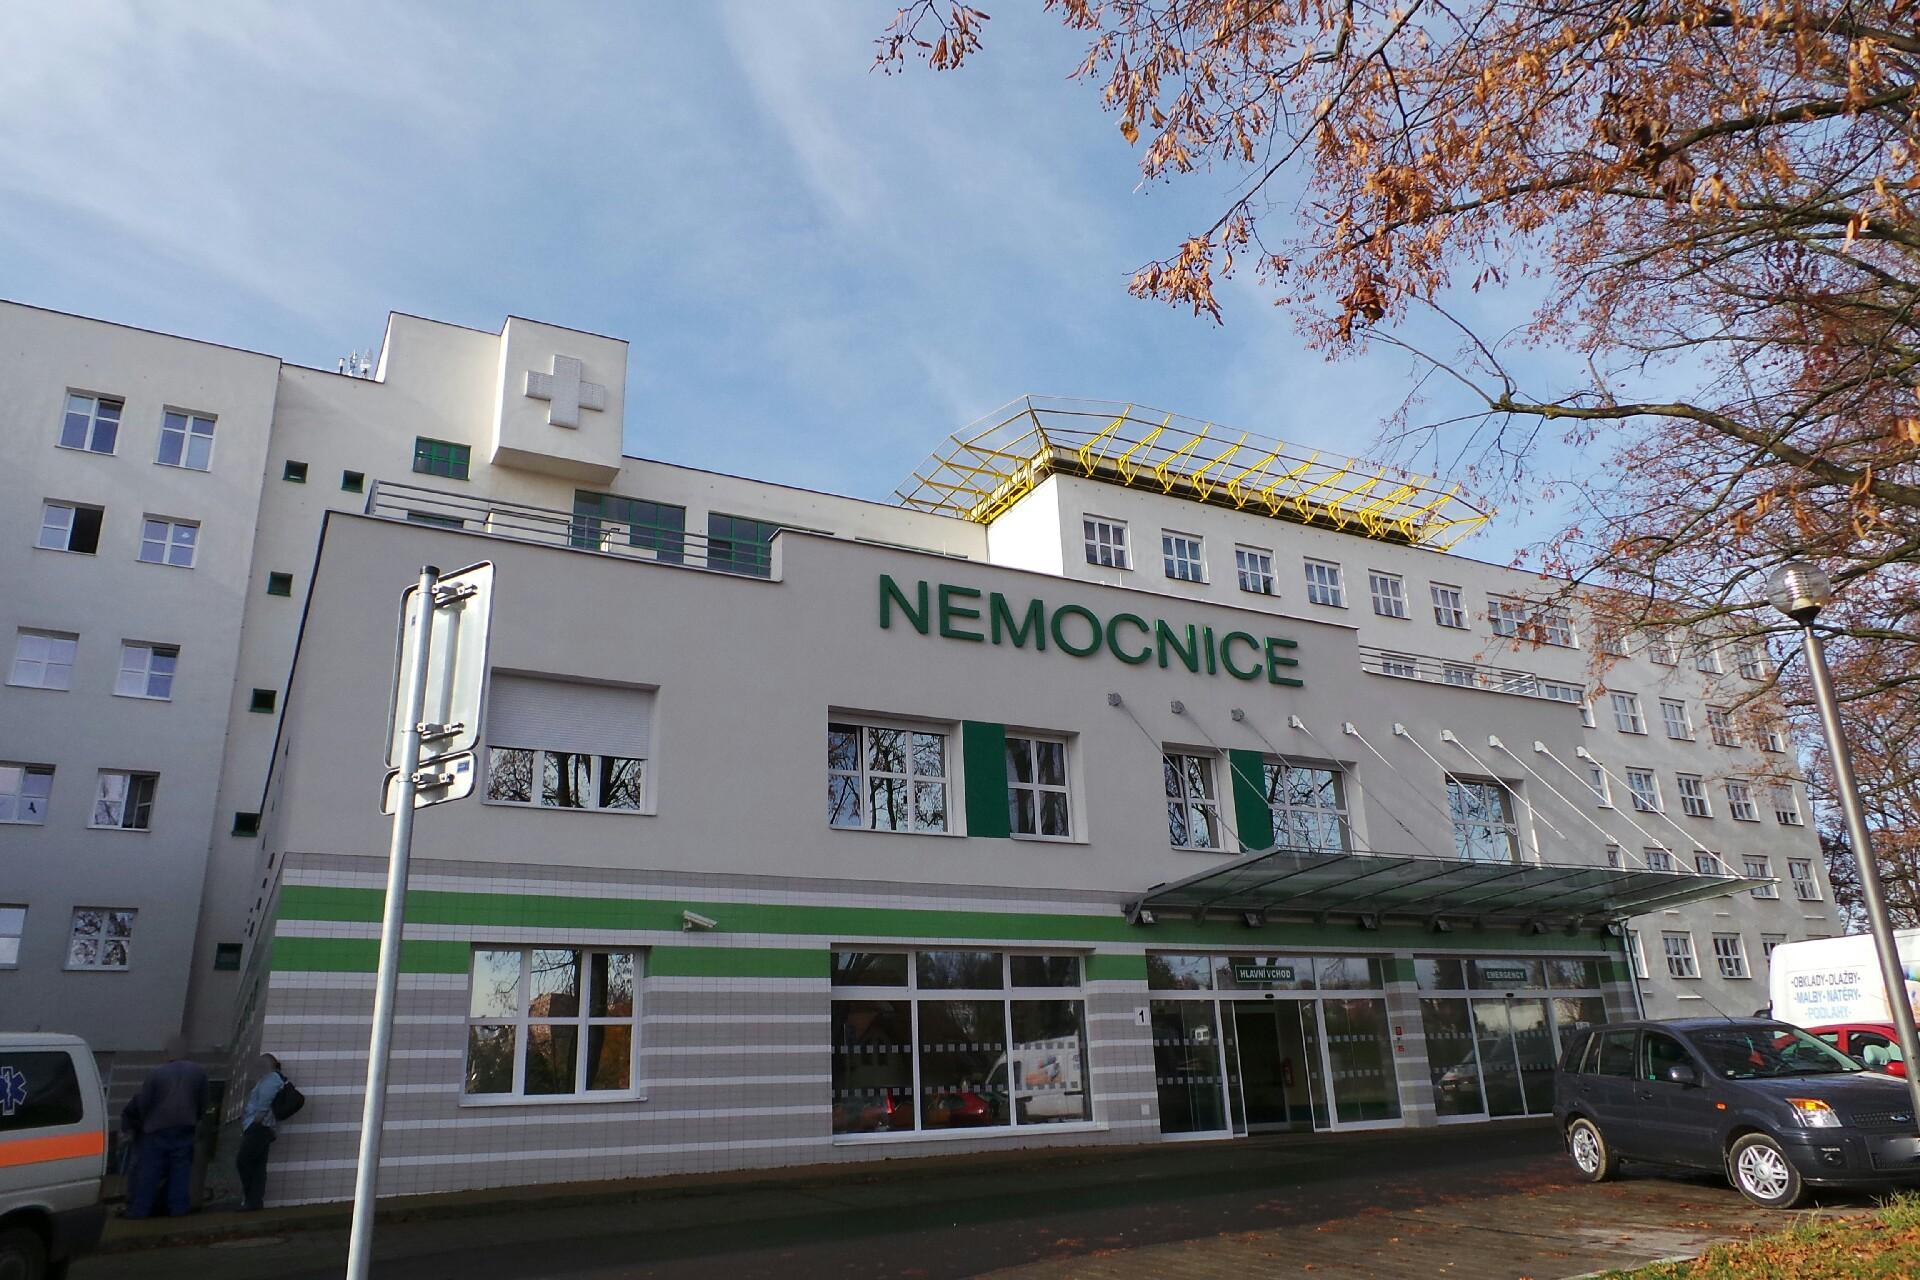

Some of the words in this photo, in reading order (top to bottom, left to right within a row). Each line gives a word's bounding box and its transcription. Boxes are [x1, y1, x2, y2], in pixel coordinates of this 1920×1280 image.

[879, 573, 1304, 687] NEMOCNICE
[1240, 968, 1266, 979] HLAVNÍ
[1266, 969, 1291, 979] VCHOD
[1139, 1009, 1145, 1023] 1
